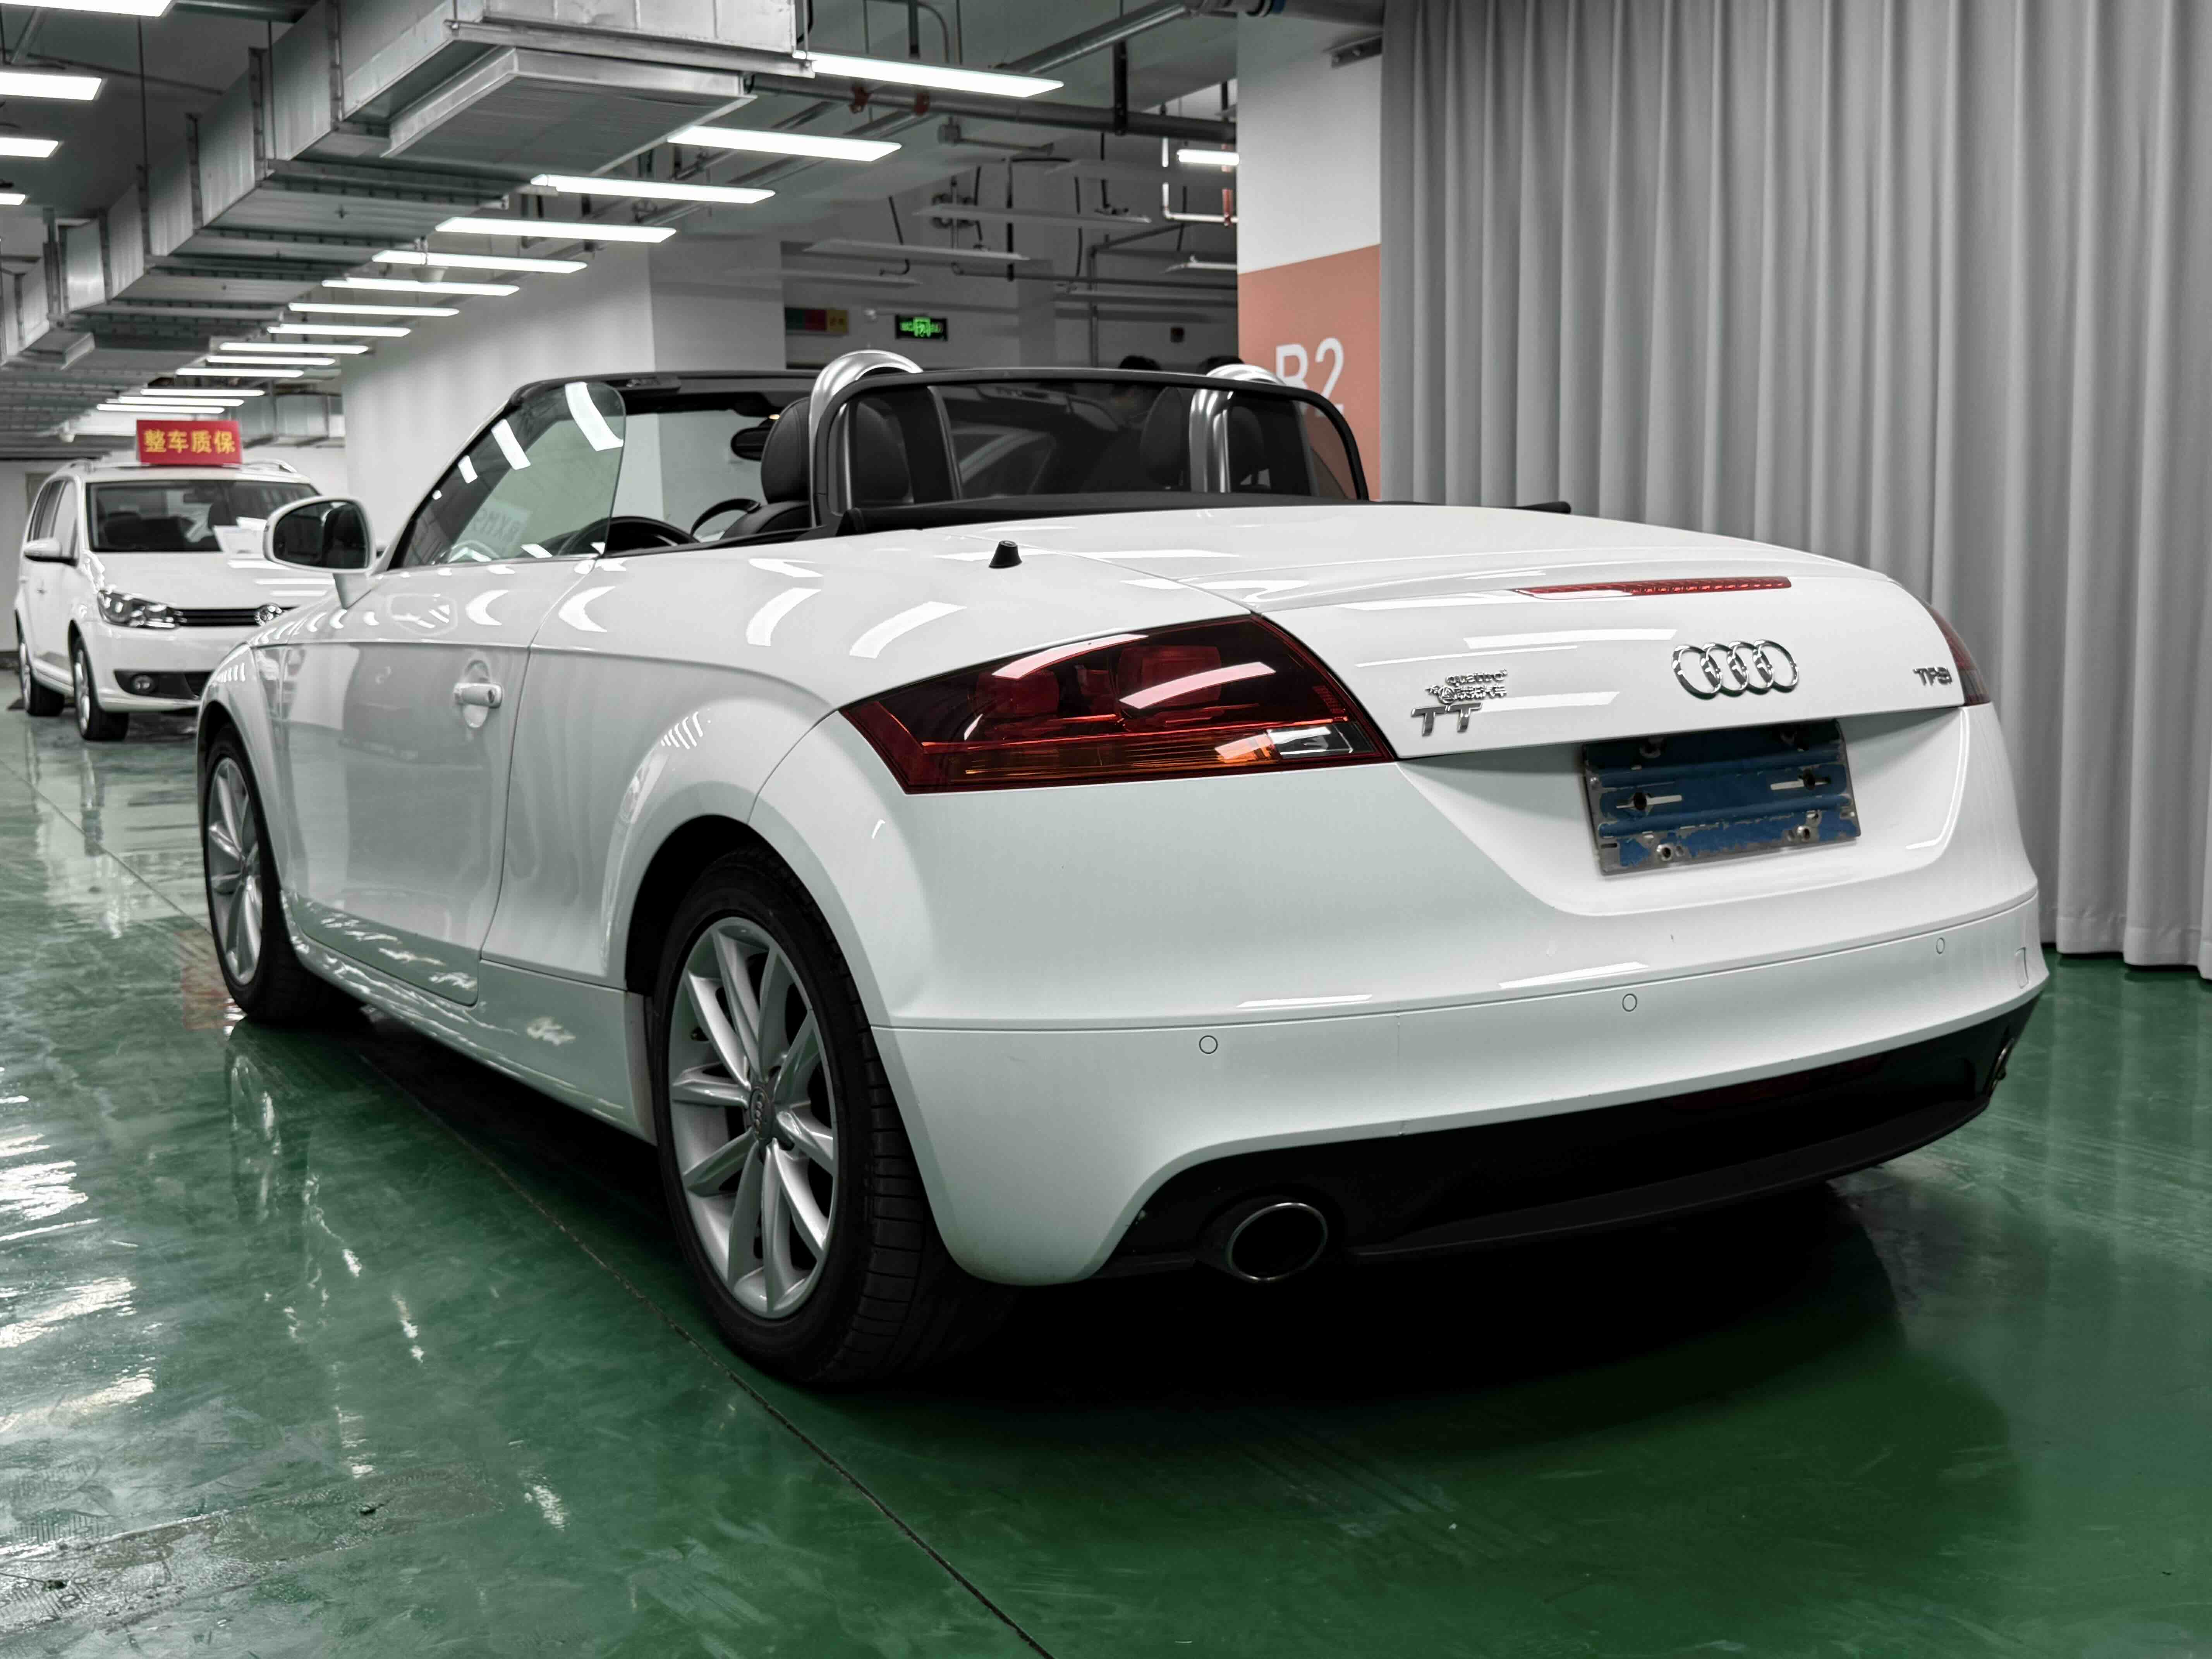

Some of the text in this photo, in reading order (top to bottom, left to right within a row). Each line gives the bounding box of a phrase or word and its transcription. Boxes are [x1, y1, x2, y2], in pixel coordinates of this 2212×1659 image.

[144, 428, 235, 454] 整车质保
[1411, 702, 1483, 737] TT
